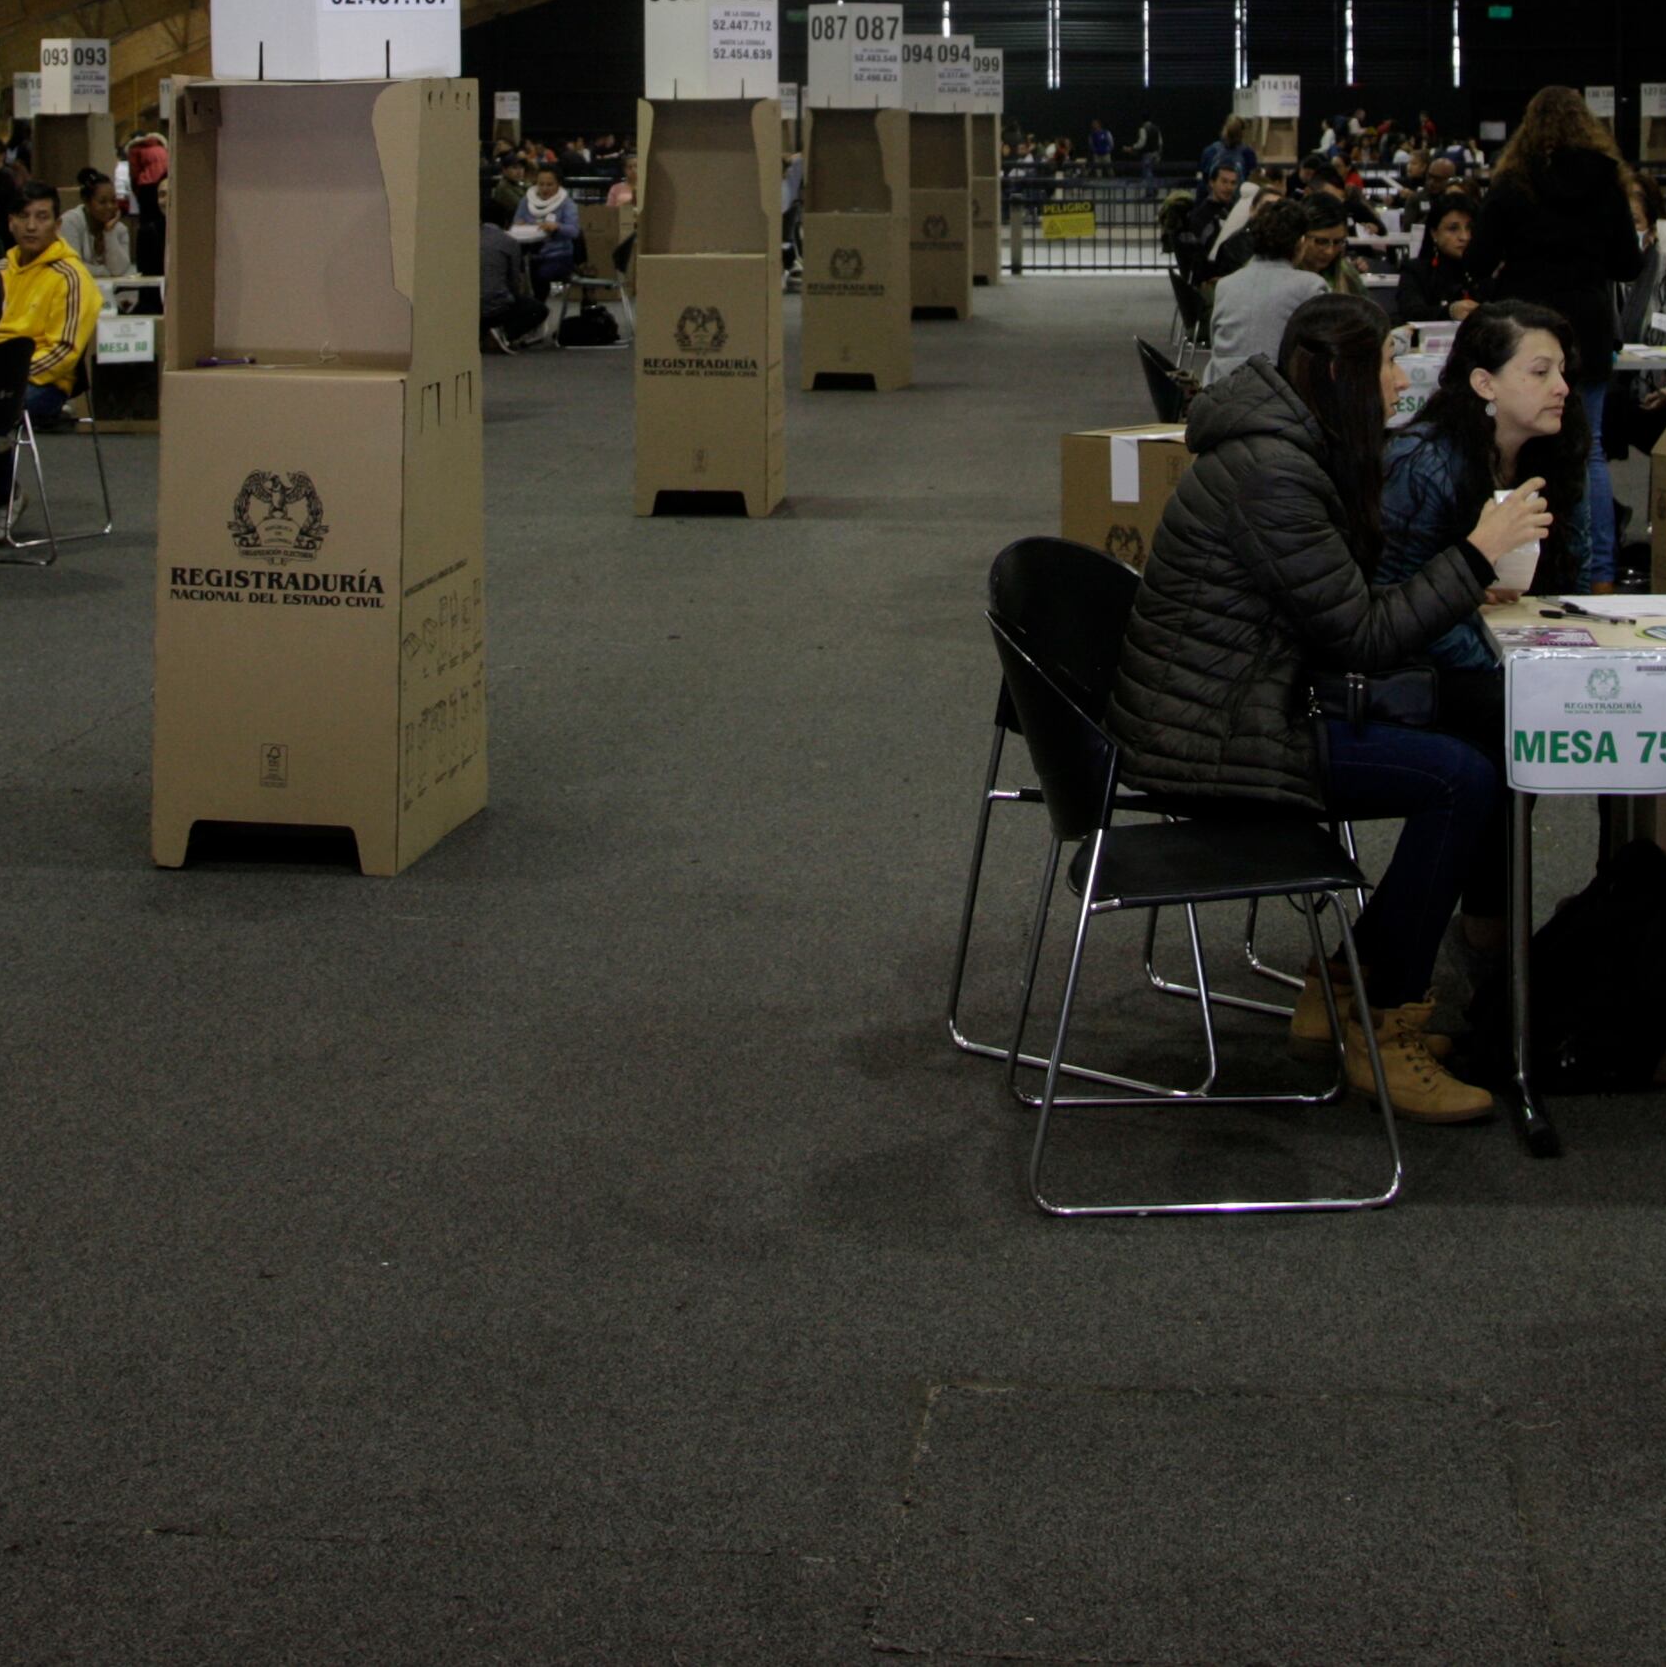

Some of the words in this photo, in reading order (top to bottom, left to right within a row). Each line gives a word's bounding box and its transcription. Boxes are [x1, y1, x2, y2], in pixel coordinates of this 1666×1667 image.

[712, 20, 773, 31] 52.447.712
[811, 16, 848, 41] 087
[855, 16, 899, 41] 087
[43, 48, 69, 66] 093
[74, 48, 107, 66] 093
[713, 48, 772, 60] 52.454.639
[902, 44, 933, 63] 094
[937, 44, 972, 63] 094
[973, 56, 1001, 72] 099
[1043, 202, 1091, 215] PELIGRO
[643, 357, 758, 370] REGISTRADURÍA
[1396, 396, 1427, 412] ESA
[170, 567, 384, 594] REGISTRADURÍA
[170, 588, 243, 602] NACIONAL
[248, 593, 278, 604] DEL
[283, 594, 340, 607] ESTADO
[345, 596, 384, 608] CIVIL
[1564, 701, 1642, 709] REGISTRADURÍA
[1514, 730, 1618, 763] MESA
